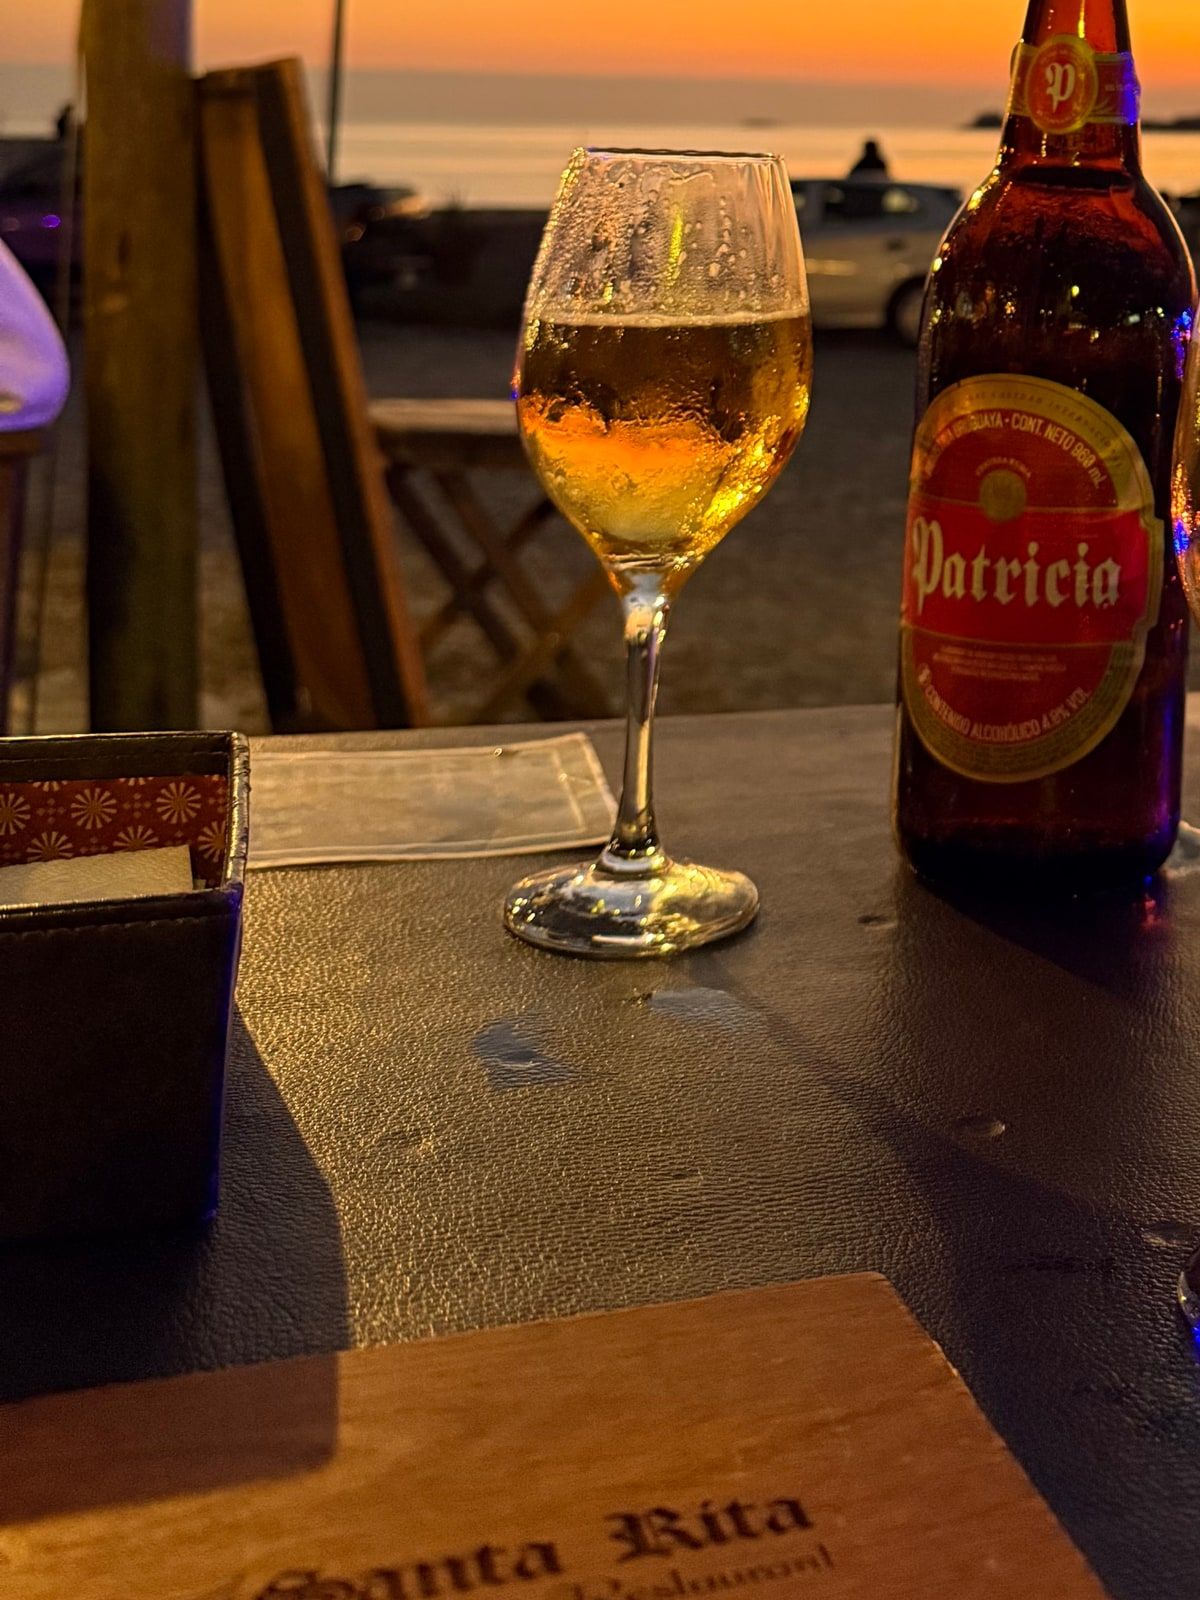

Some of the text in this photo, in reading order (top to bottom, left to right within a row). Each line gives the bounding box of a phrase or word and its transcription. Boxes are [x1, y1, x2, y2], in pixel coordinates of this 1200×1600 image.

[1010, 412, 1044, 436] CONT.
[1044, 425, 1076, 451] NETO
[911, 515, 1122, 617] Patricia
[924, 683, 972, 735] CONTENIDO
[602, 1495, 815, 1564] Rita
